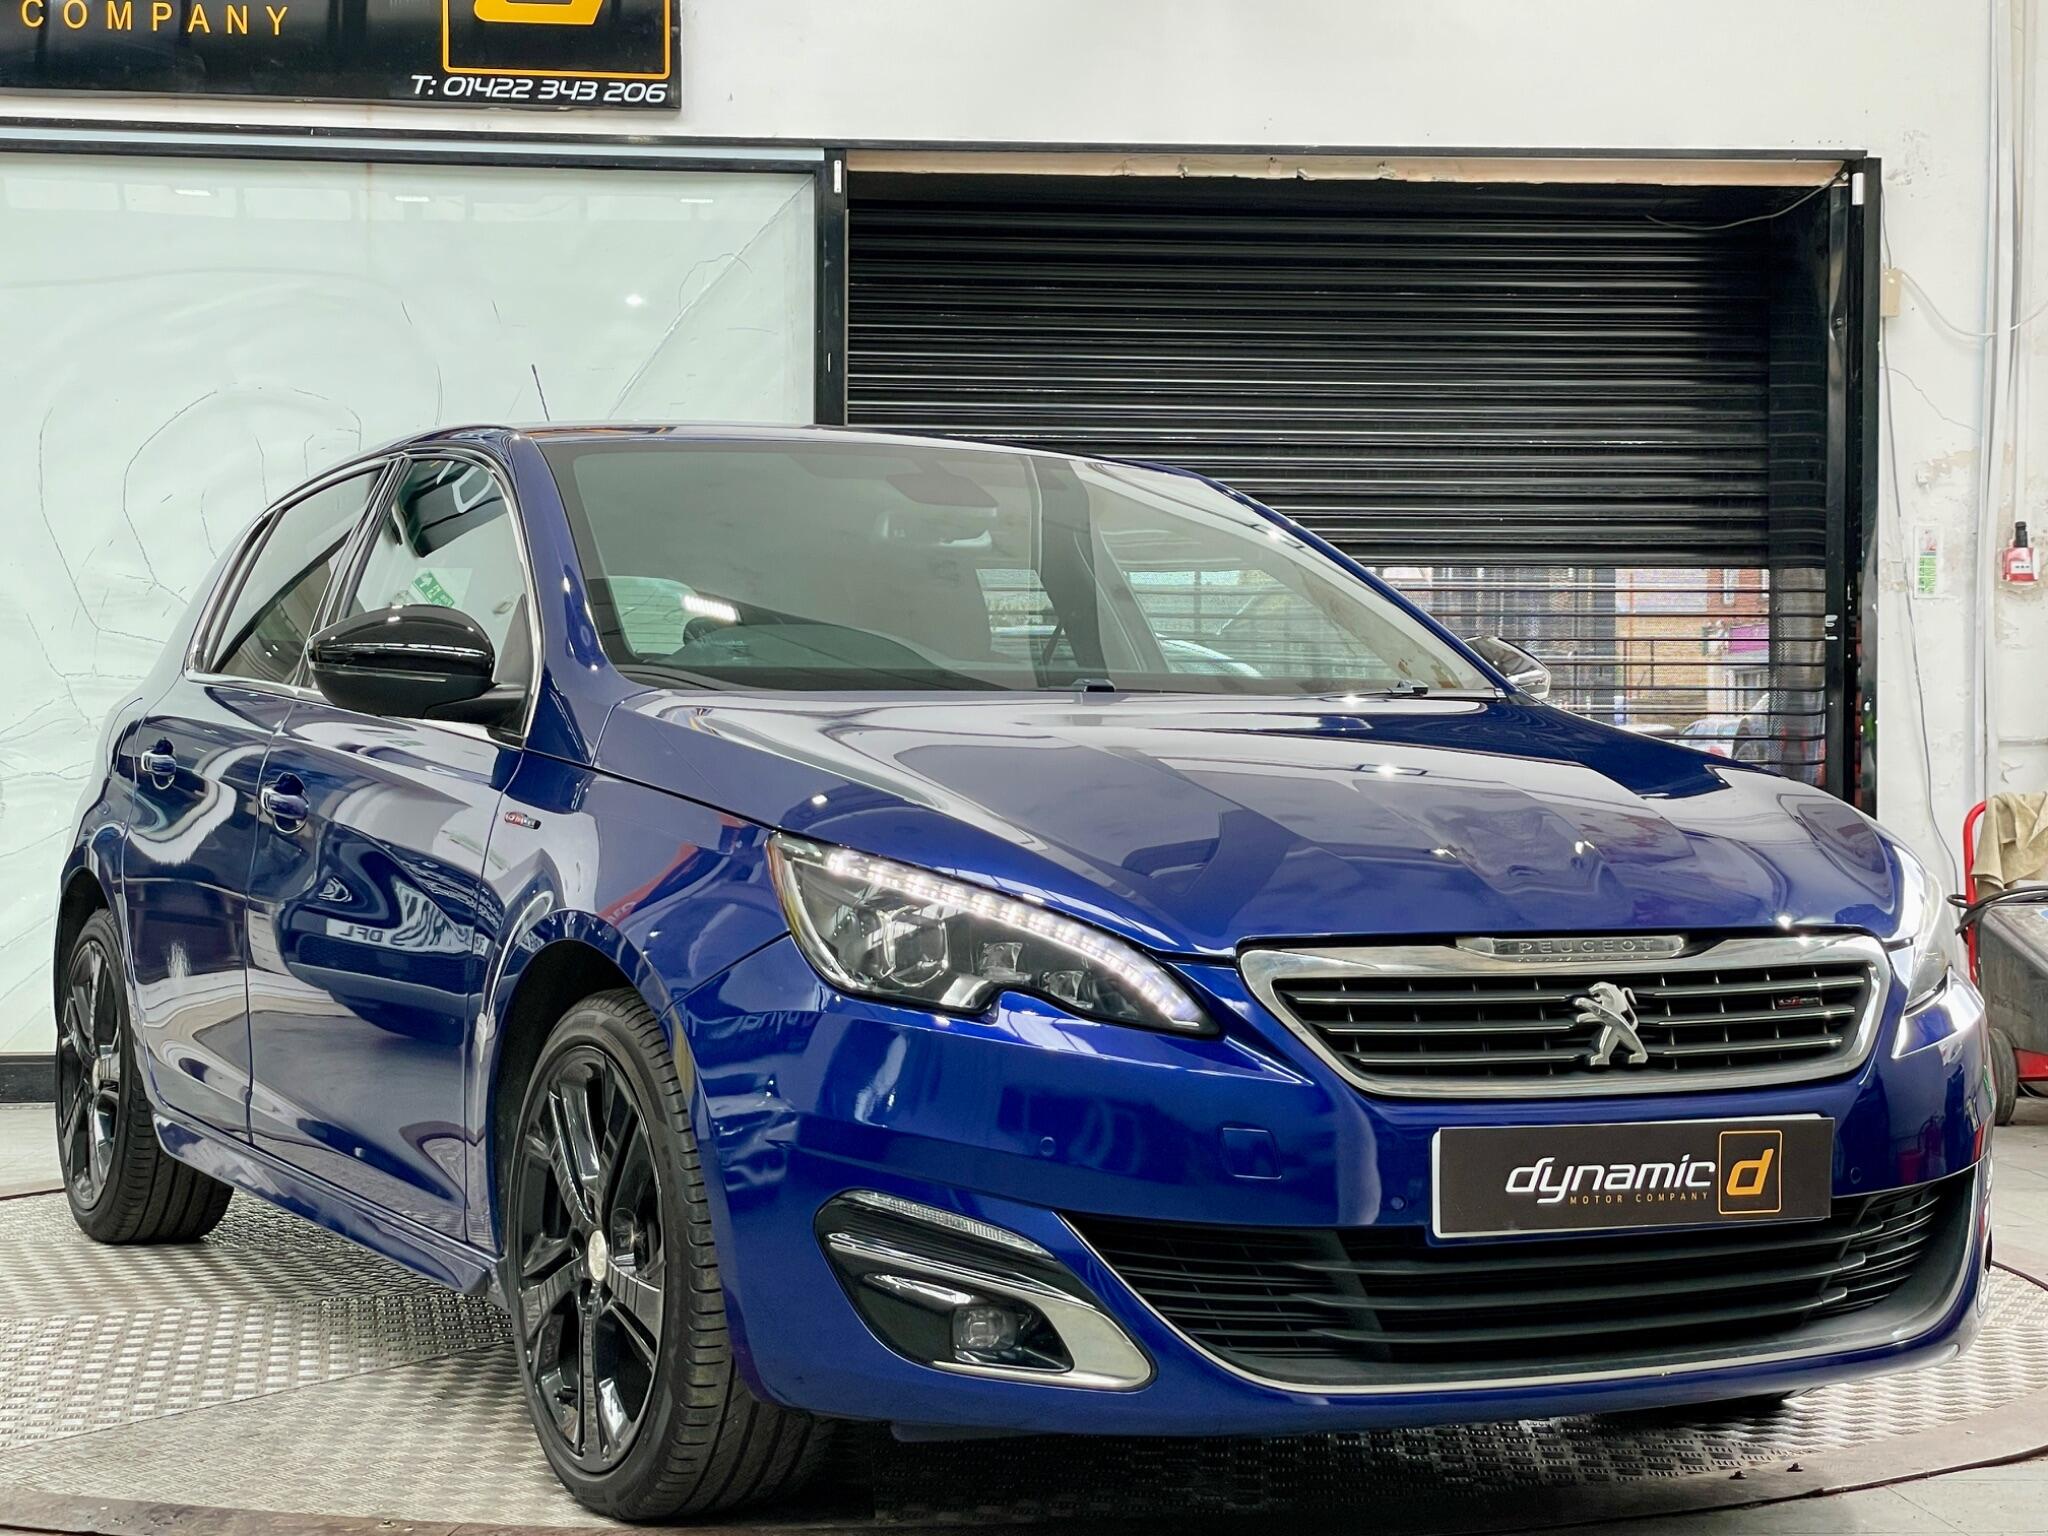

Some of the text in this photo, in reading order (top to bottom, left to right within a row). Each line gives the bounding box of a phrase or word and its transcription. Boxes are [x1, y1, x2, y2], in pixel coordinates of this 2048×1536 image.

[21, 0, 288, 36] COMPANY
[411, 74, 668, 104] T: 01422 343 206
[1505, 1154, 1716, 1204] dynamic
[1726, 1148, 1775, 1196] d
[1570, 1191, 1709, 1205] MOTOR COMPANY
